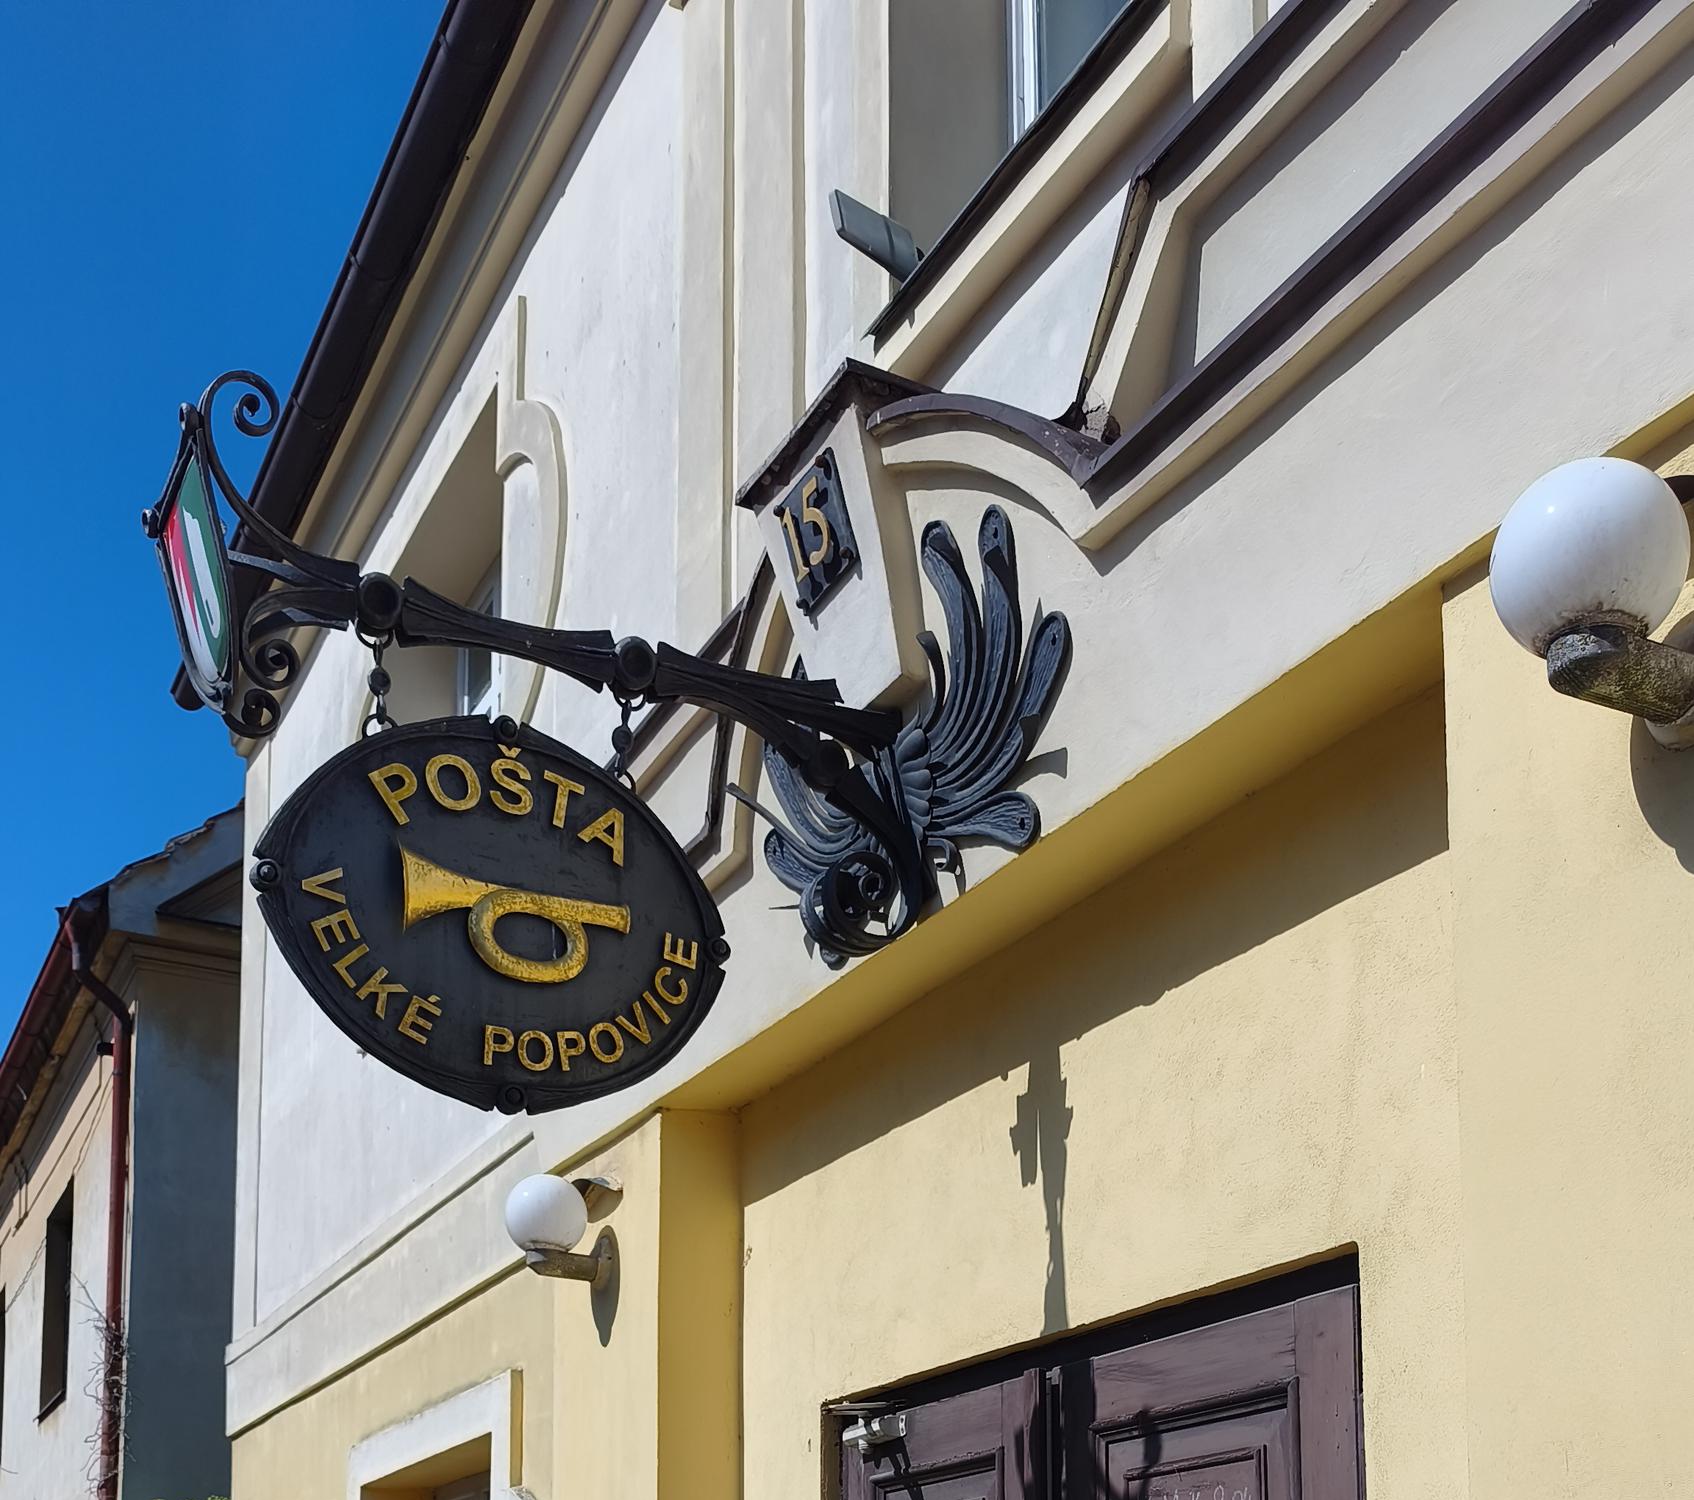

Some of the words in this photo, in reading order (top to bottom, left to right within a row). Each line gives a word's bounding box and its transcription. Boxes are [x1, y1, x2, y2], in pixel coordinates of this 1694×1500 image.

[782, 476, 830, 583] 15
[368, 744, 627, 868] POŠTA
[301, 866, 443, 1046] VELKÉ
[482, 932, 699, 1073] POPOVICE
